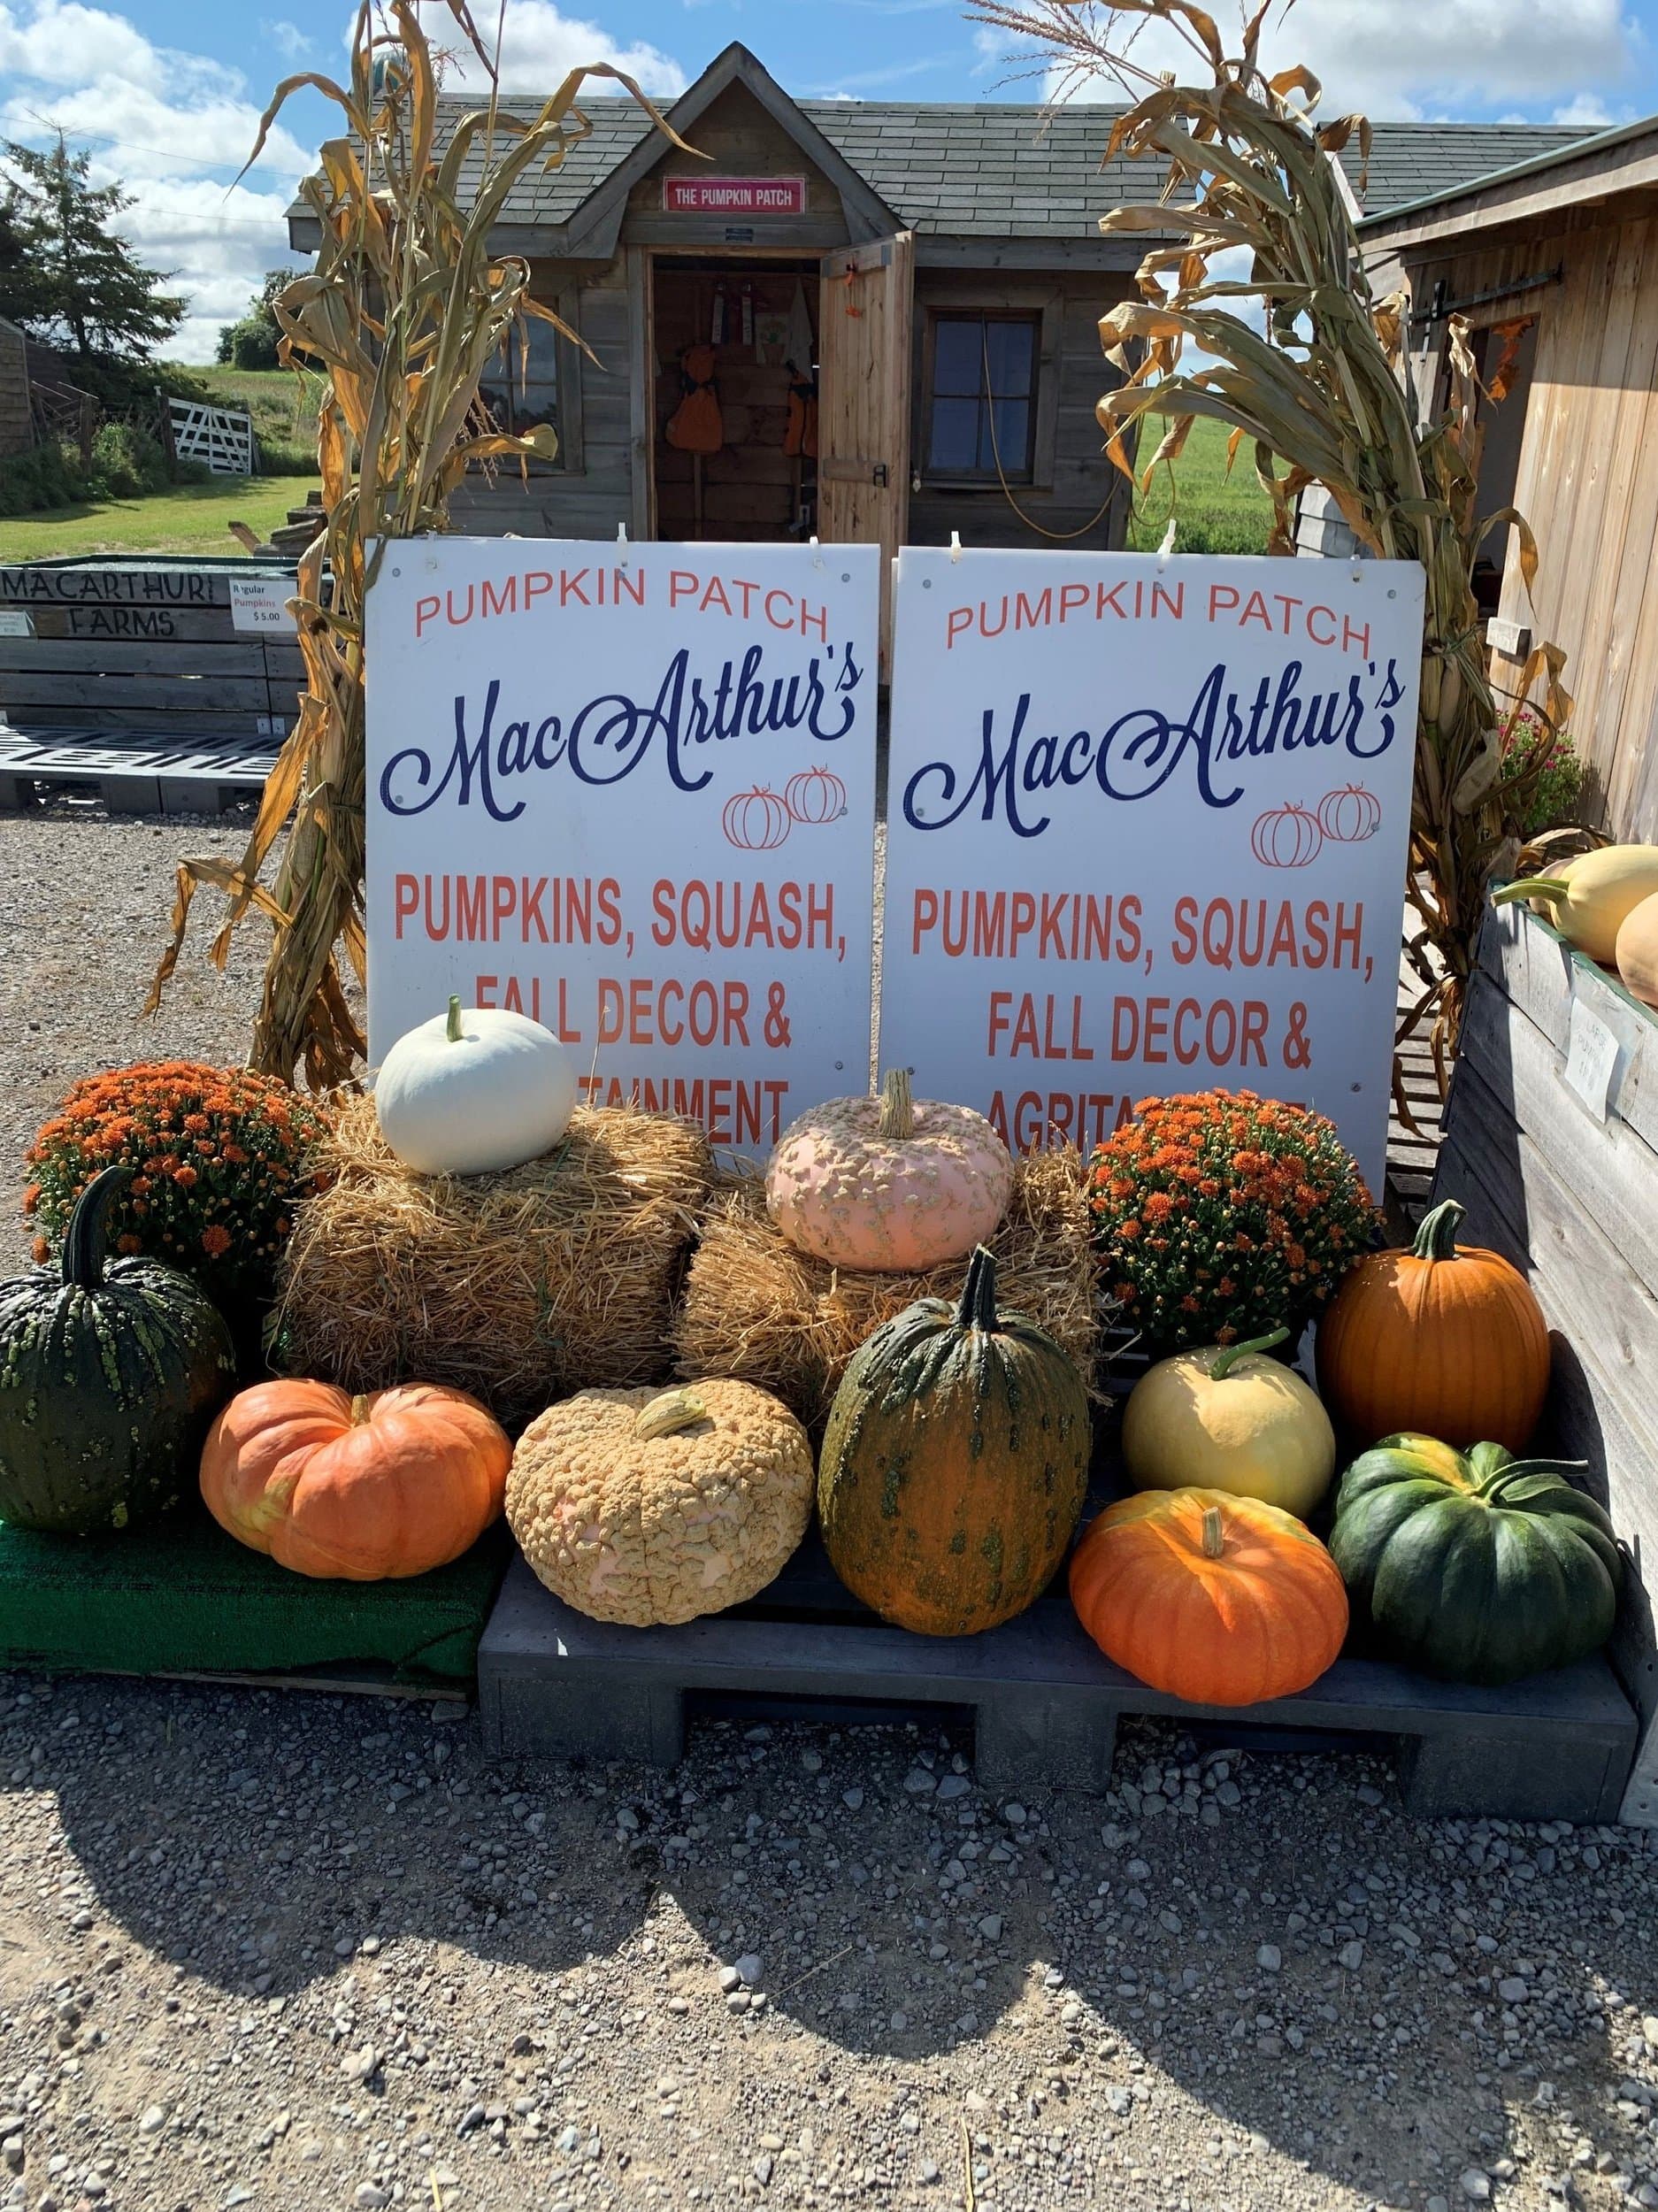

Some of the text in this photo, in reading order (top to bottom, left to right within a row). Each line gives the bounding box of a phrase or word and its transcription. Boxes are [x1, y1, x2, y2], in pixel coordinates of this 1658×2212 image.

[675, 188, 793, 206] THE PUMPKIN PATCH
[69, 607, 174, 637] FARMS
[234, 598, 276, 609] Pumpkins
[416, 568, 827, 643] PUMPKIN PATCH
[947, 580, 1370, 660] PUMPKIN PATCH
[380, 641, 864, 822] MacArthur's
[902, 658, 1408, 839] MacArthur's
[395, 873, 847, 964] PUMPKINS, SQUASH,
[912, 888, 1375, 984] PUMPKINS, SQUASH,
[476, 975, 792, 1048] FALL DECOR &
[987, 991, 1311, 1070] FALL DECOR &
